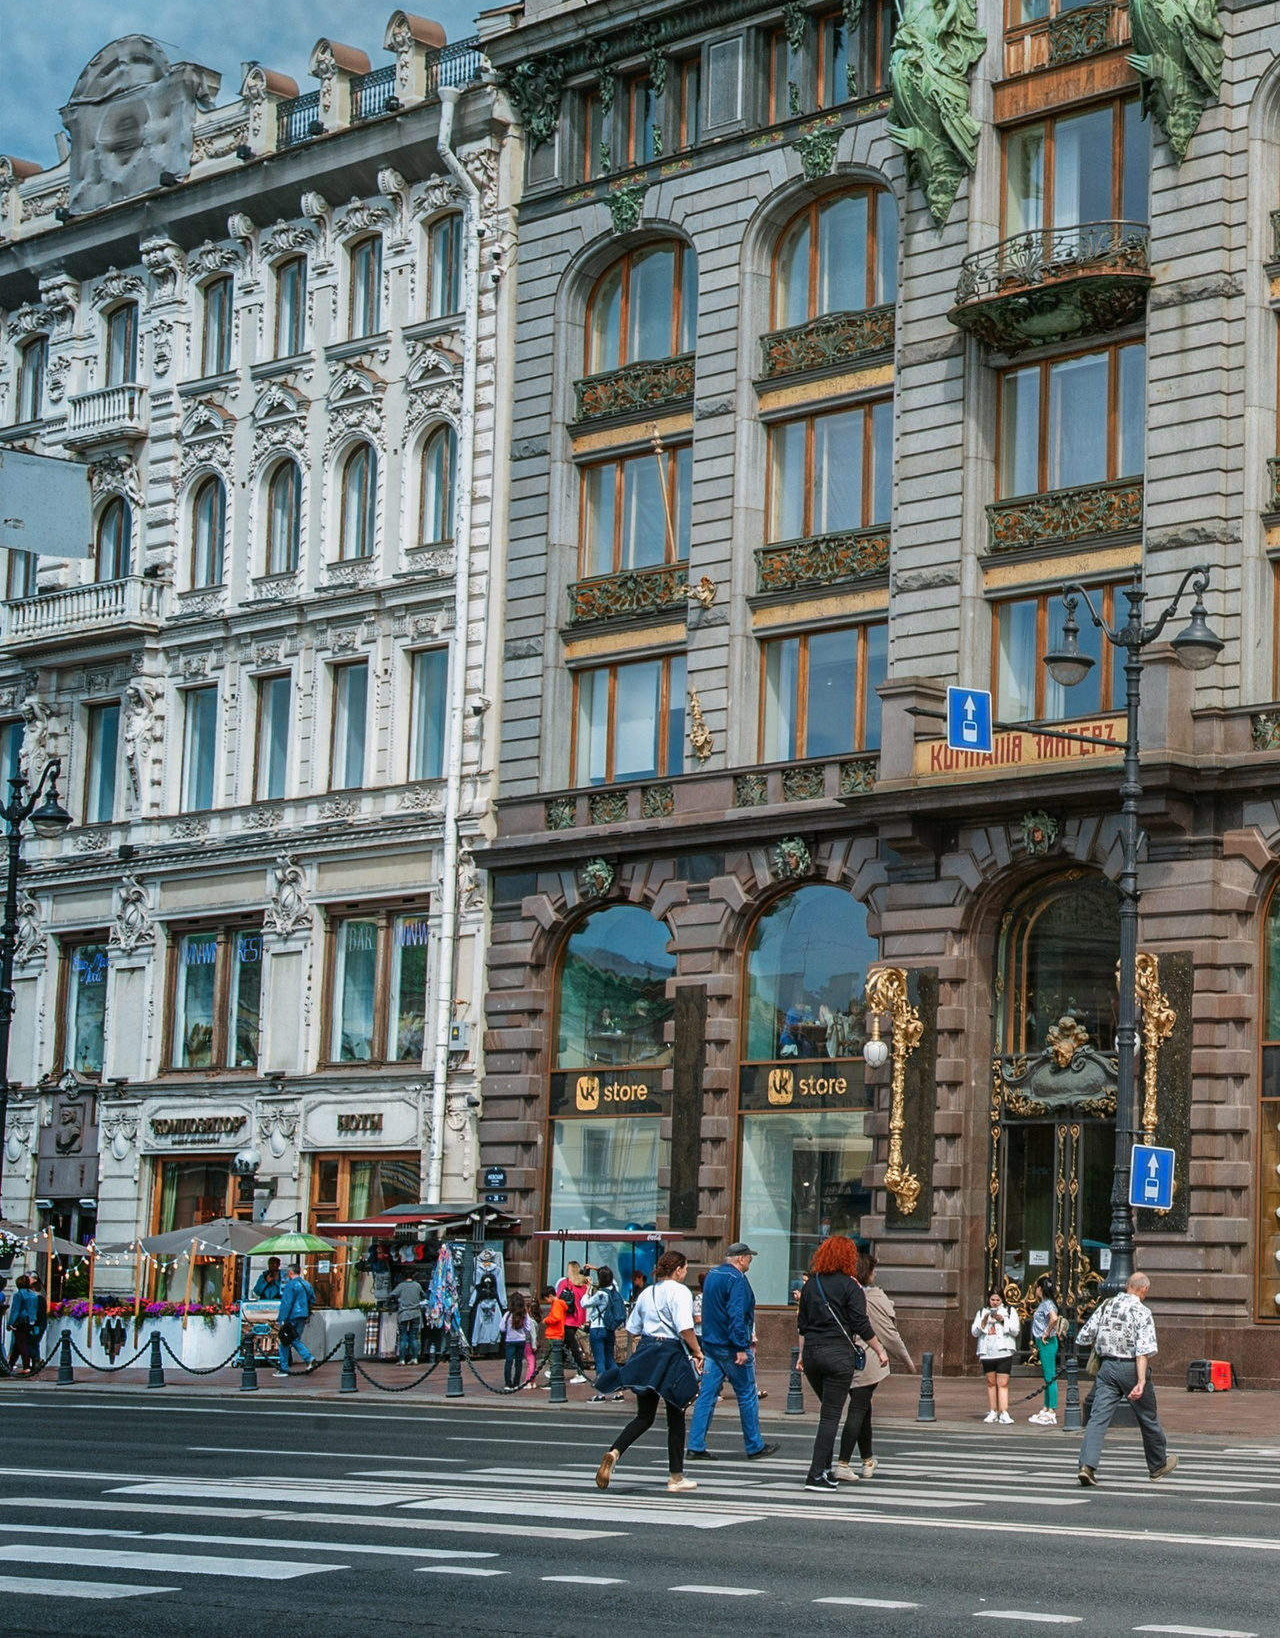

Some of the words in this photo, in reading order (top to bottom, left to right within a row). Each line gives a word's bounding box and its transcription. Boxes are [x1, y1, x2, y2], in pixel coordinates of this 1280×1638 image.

[348, 926, 373, 953] BAR
[603, 1082, 648, 1102] store
[798, 1075, 848, 1097] store
